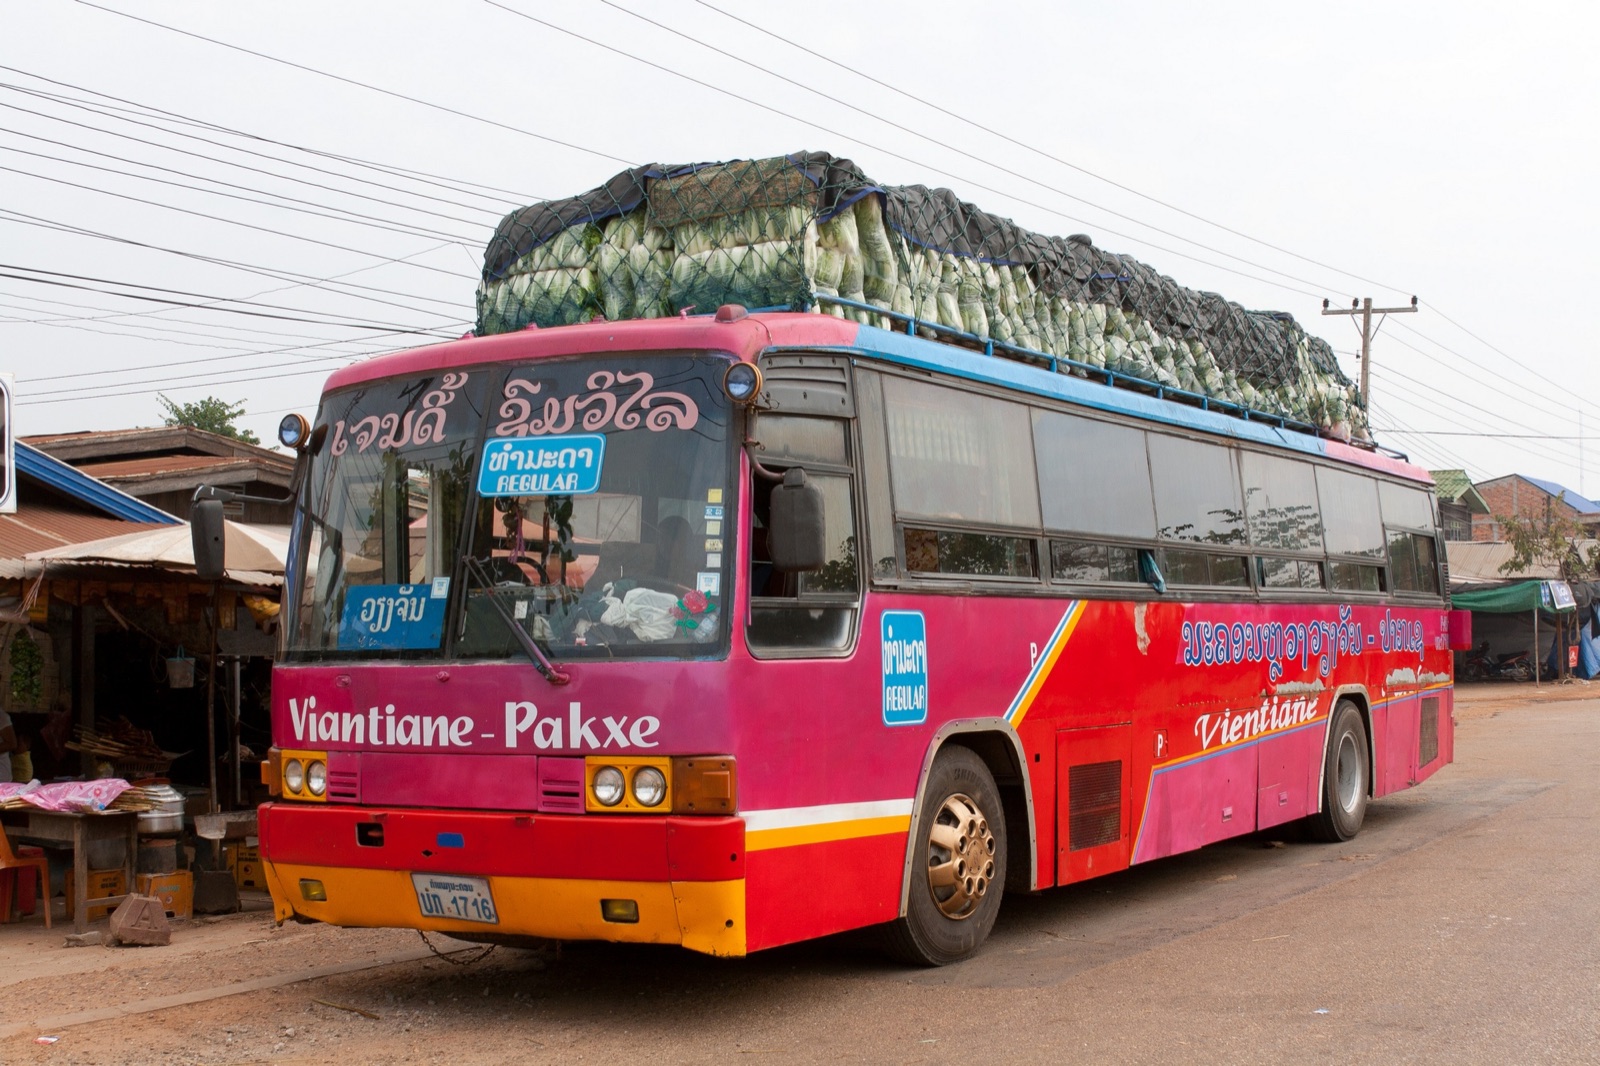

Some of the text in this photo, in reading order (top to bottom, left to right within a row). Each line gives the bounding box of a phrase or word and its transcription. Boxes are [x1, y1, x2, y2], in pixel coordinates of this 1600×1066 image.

[496, 473, 579, 493] REGULAR
[360, 586, 427, 633] ວຽງຈັນ
[1366, 633, 1376, 645] -
[1029, 641, 1038, 668] P
[885, 684, 926, 712] REGULAR
[288, 695, 661, 750] Viantiane - Pakxe
[1194, 695, 1320, 751] Vientiane
[1157, 733, 1164, 757] P
[450, 895, 493, 920] 1716
